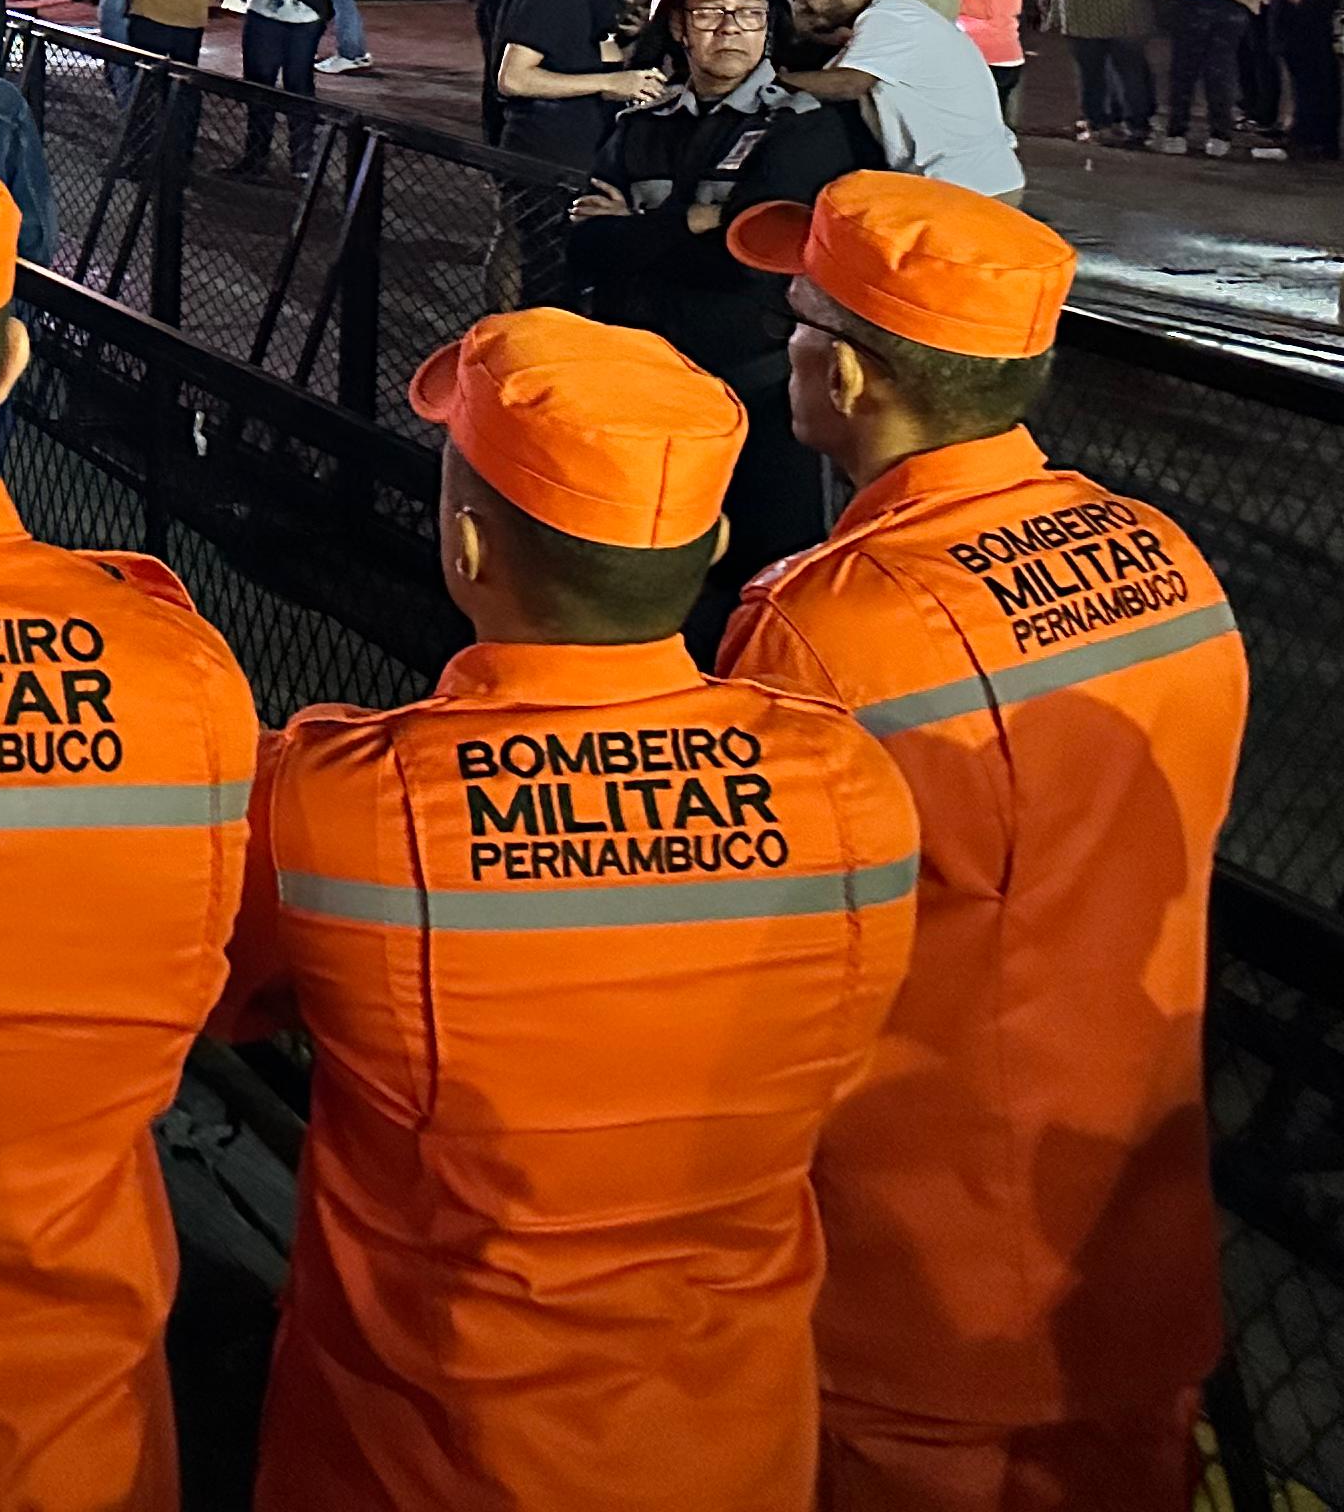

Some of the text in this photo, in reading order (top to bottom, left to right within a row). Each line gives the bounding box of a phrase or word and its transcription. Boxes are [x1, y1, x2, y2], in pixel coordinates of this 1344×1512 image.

[946, 500, 1138, 574] BOMBEIRO
[982, 529, 1173, 616] MILITAR
[1012, 570, 1188, 654] PERNAMBUCO
[457, 726, 761, 779] BOMBEIRO
[467, 774, 779, 836] MILITAR
[471, 829, 788, 881] PERNAMBUCO
